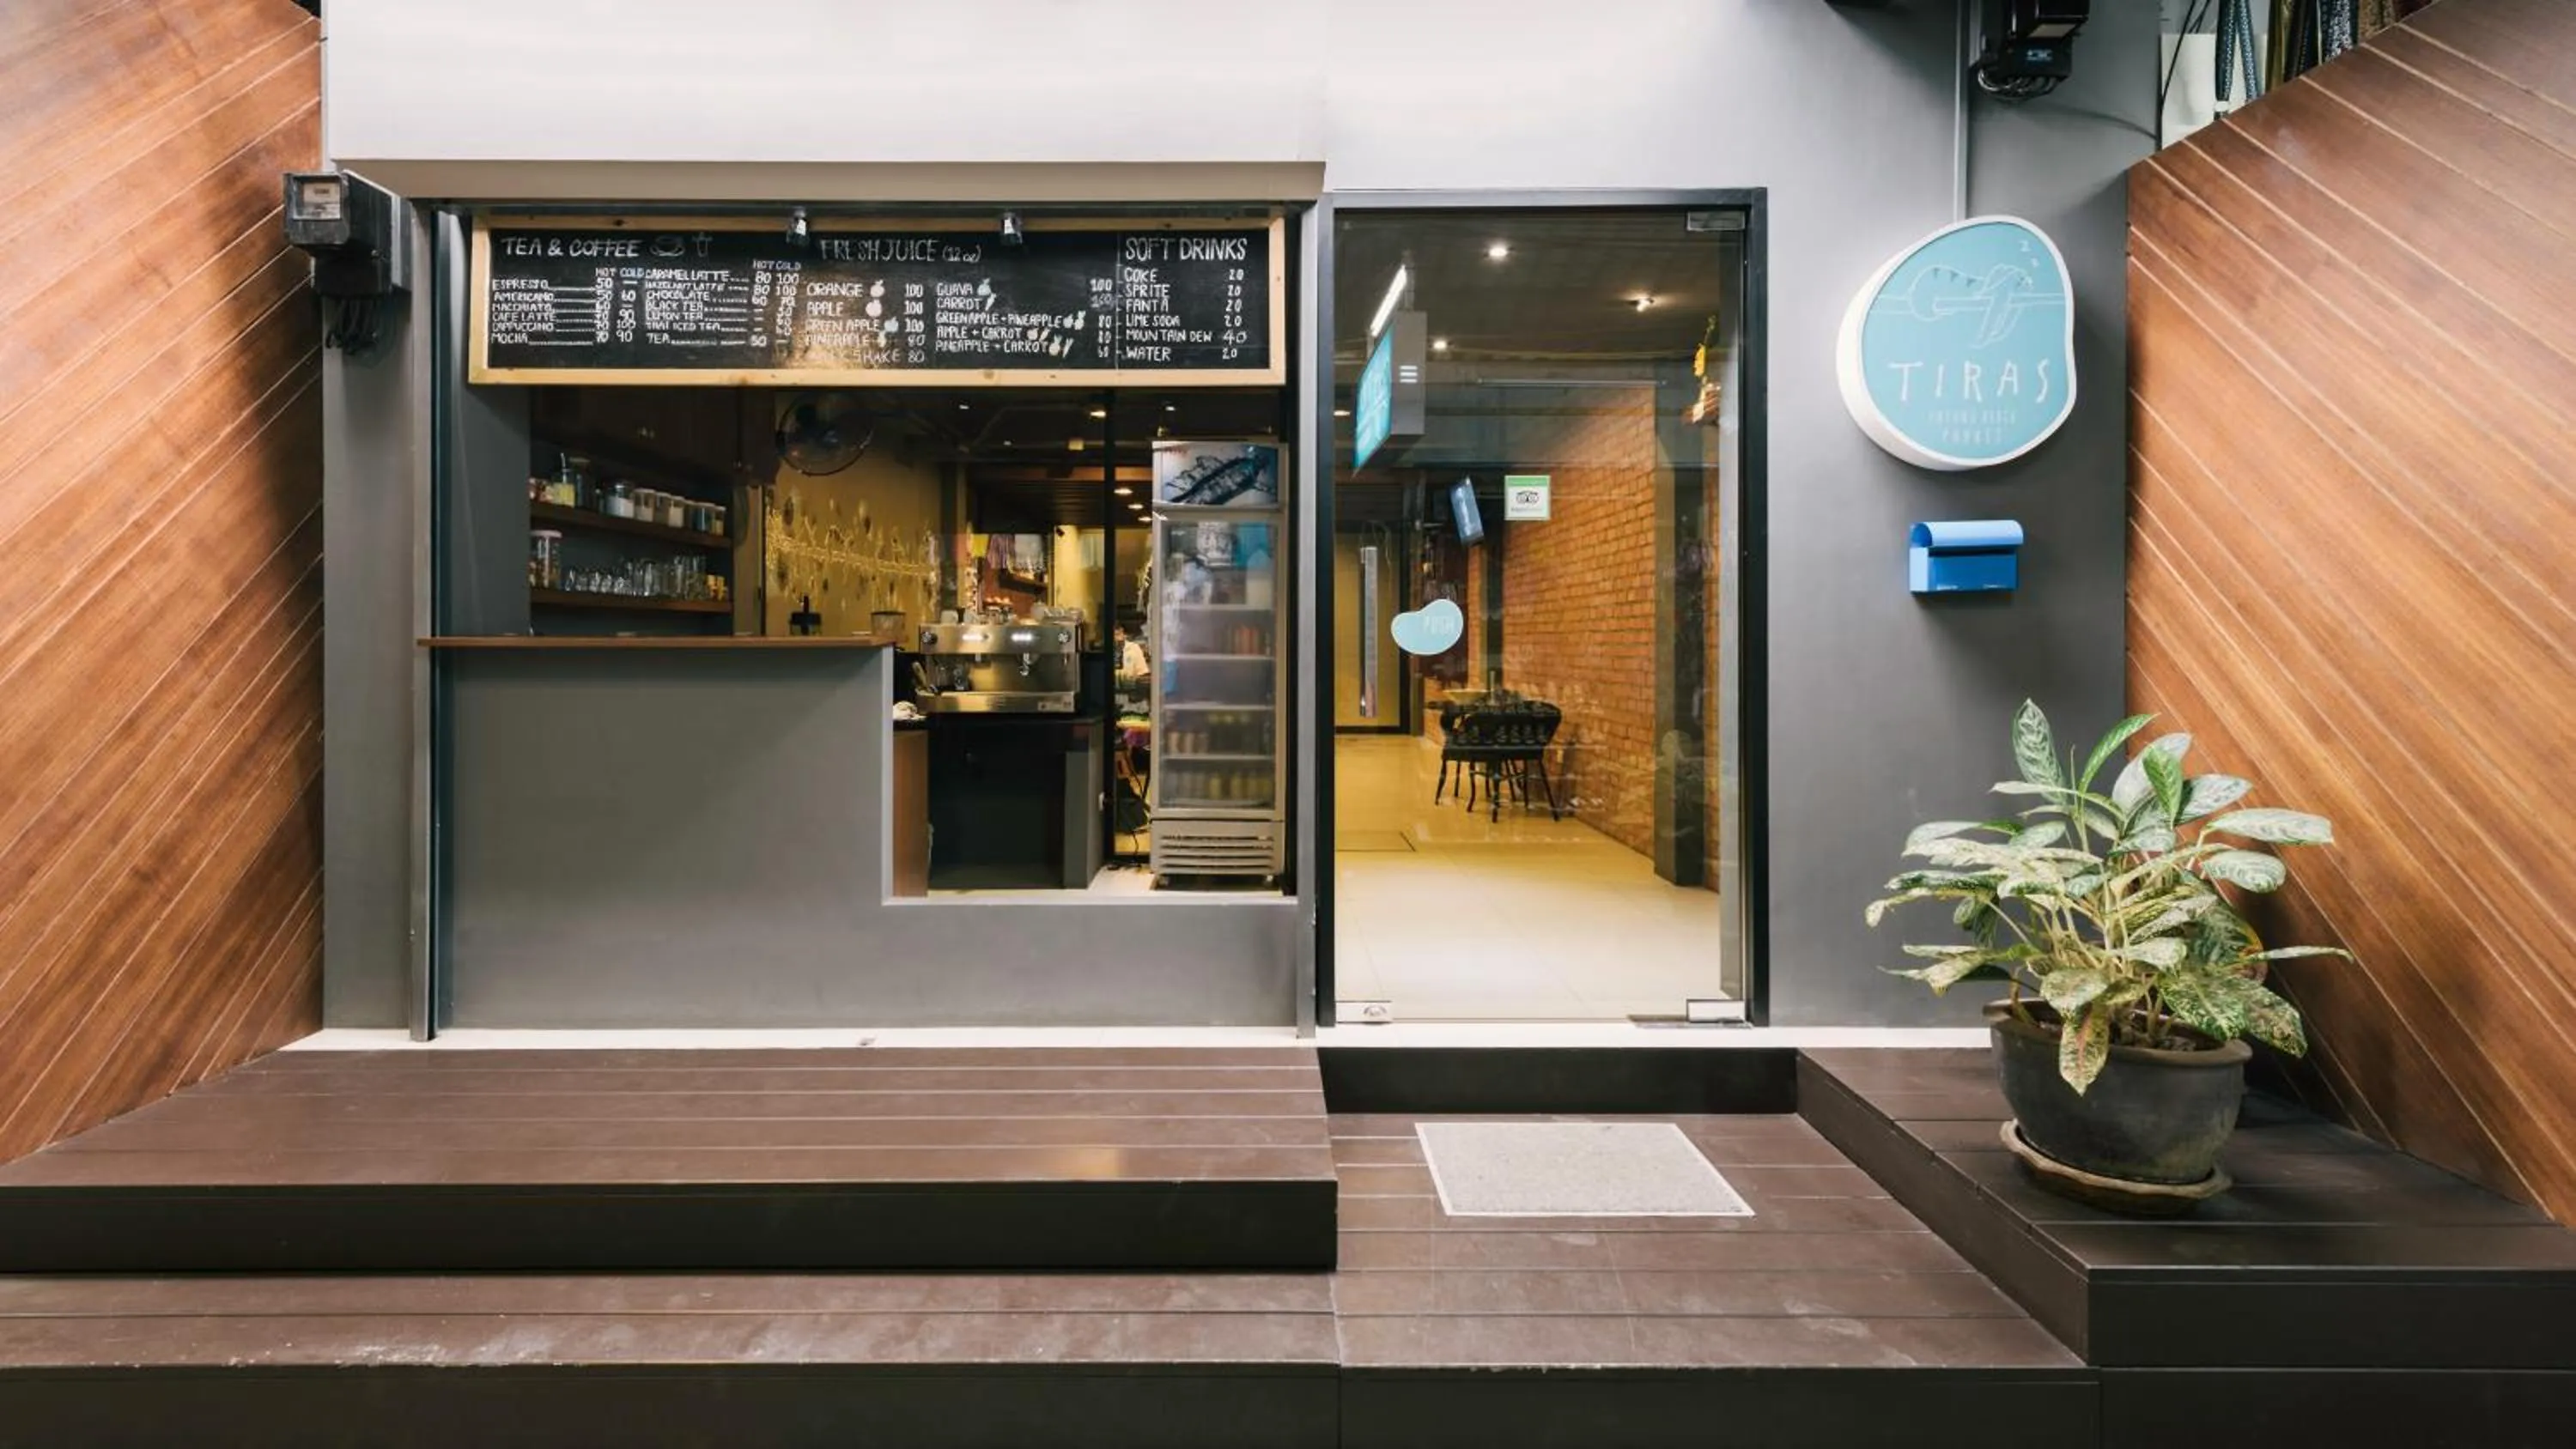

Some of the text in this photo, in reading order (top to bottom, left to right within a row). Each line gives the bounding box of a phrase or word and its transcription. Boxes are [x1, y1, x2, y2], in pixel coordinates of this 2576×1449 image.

[501, 238, 641, 257] TEA & COFFEE
[821, 239, 880, 261] FRESH
[882, 239, 939, 262] JUICE
[1126, 238, 1248, 261] SOFT DRINKS
[753, 259, 801, 271] HOT COLD
[595, 267, 644, 278] HOT COLD
[645, 269, 799, 285] CARAMEL LATTE 80 100
[1124, 267, 1244, 283] COKE 20
[492, 277, 613, 290] ESPRESSO 50
[753, 284, 770, 295] 80
[775, 285, 797, 296] 100
[807, 282, 923, 297] ORANGE 100
[937, 279, 1112, 295] GUAVA 100
[494, 292, 554, 301] AMERICANO
[647, 290, 710, 301] CHOCOLATE
[1126, 284, 1242, 298] SPRITE 20
[646, 300, 678, 310] BLACK
[683, 301, 703, 311] TEA
[807, 300, 923, 317] APPLE 100
[937, 297, 982, 309] CARROT
[1126, 299, 1242, 312] FANTA 20
[521, 312, 556, 322] LATTE
[683, 312, 703, 321] TEA
[1126, 314, 1242, 327] LIME SODA 20
[699, 322, 720, 331] TEA
[846, 319, 880, 332] APPLE
[904, 318, 925, 333] 100
[491, 332, 528, 344] MOCHA
[617, 330, 633, 343] 90
[646, 332, 671, 344] TEA
[937, 326, 968, 339] APPLE
[981, 327, 1022, 339] CARROT
[1126, 330, 1247, 345] MOUNTAIN DEW 40
[1004, 342, 1048, 353] CARROT
[1126, 347, 1237, 361] WATER 20
[1887, 358, 2050, 403] TIRAS
